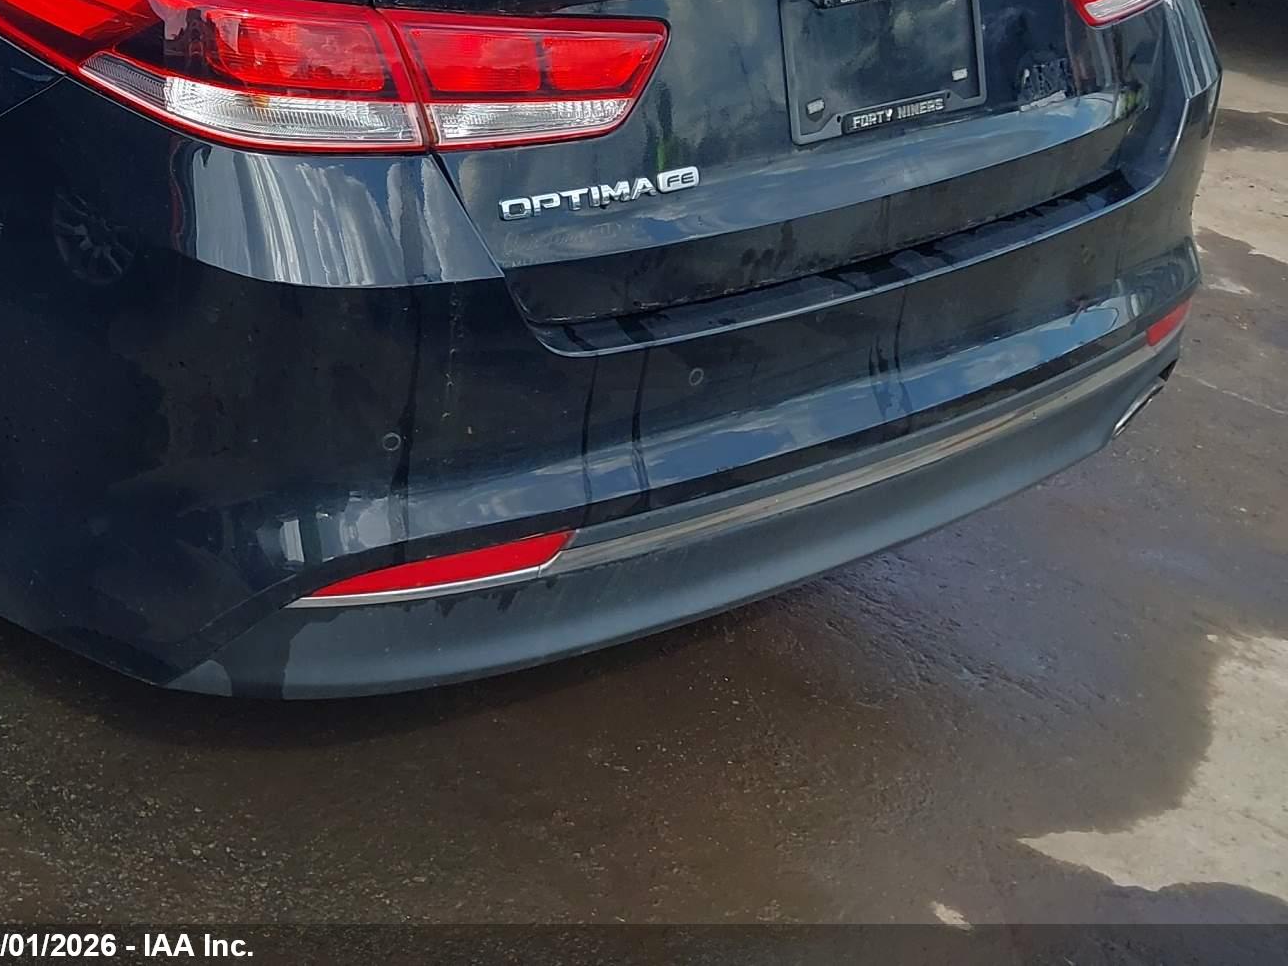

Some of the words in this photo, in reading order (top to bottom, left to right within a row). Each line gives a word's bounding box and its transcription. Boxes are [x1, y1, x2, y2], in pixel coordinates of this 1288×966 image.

[852, 109, 893, 130] FORTY
[897, 98, 945, 120] NINERS
[498, 177, 658, 222] OPTIMA
